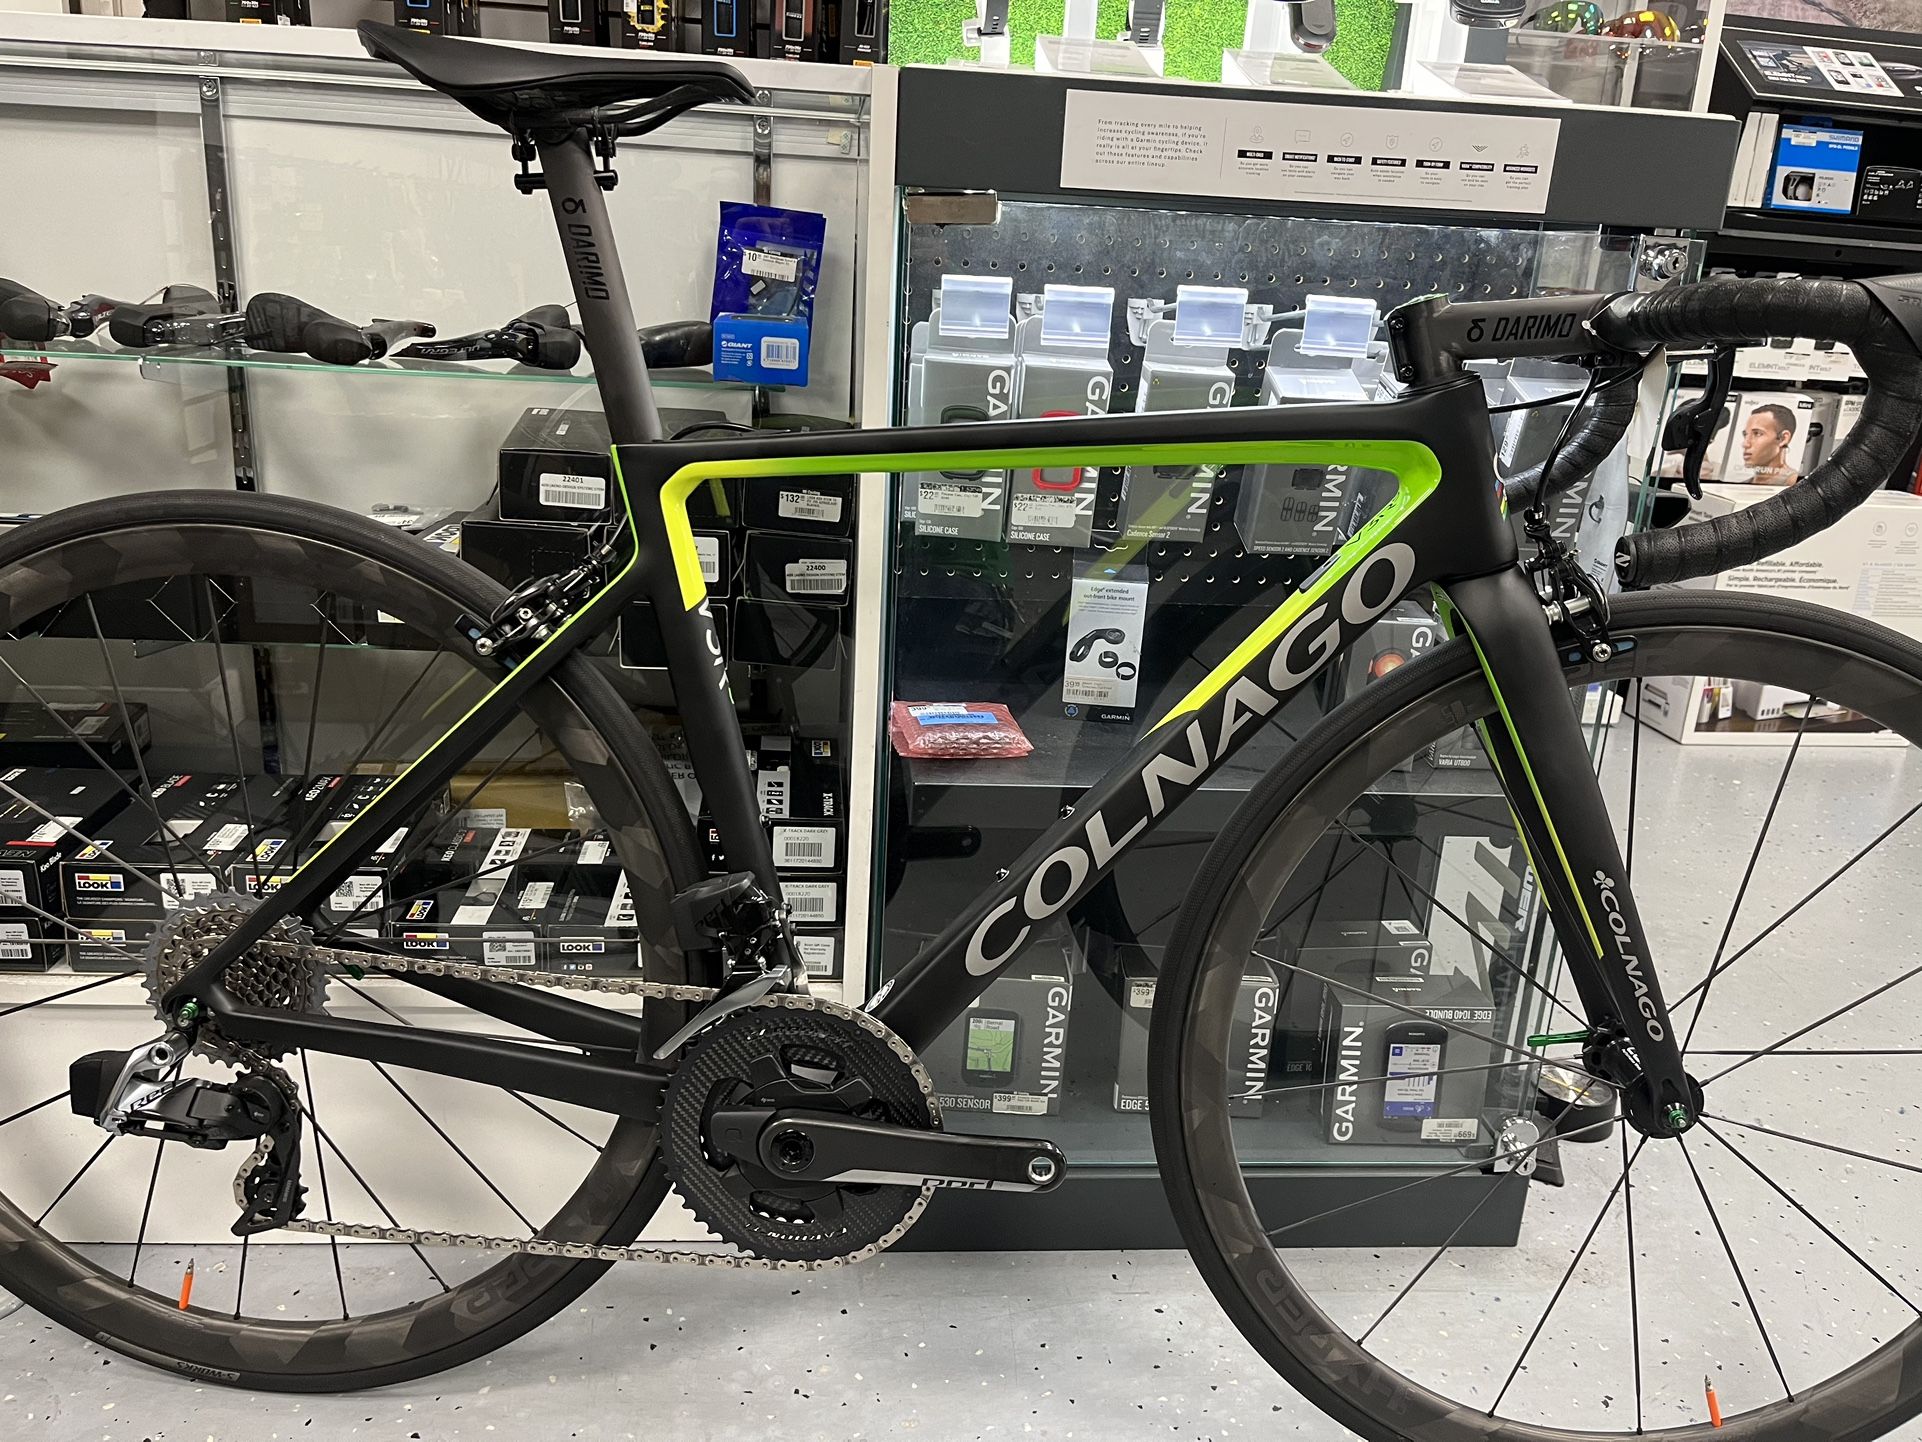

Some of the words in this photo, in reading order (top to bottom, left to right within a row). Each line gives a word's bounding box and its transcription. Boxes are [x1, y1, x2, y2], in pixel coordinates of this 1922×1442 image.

[1141, 121, 1157, 129] every
[1180, 124, 1202, 132] helping
[568, 224, 610, 300] DARIMO
[1491, 313, 1577, 342] DARIMO
[562, 476, 584, 484] 22401
[920, 490, 934, 500] $22
[1014, 502, 1027, 511] $22
[919, 524, 944, 534] SILICONE
[945, 527, 958, 535] CASE
[1127, 529, 1147, 537] Cadence
[1148, 530, 1165, 538] Sensor
[1010, 531, 1035, 539] SILICONE
[966, 542, 1416, 976] COLNAGO
[78, 881, 110, 889] LOOK
[405, 940, 435, 948] LOOK
[1600, 889, 1664, 1042] COLNAGO
[1426, 1010, 1452, 1019] BUNDLE
[1454, 1010, 1470, 1019] 1040
[1473, 1010, 1492, 1019] EDGE
[1040, 987, 1068, 1098] GARMIN
[1245, 987, 1274, 1100] GARMIN
[1333, 1026, 1363, 1141] GARMIN
[940, 1097, 955, 1107] 530
[957, 1098, 991, 1109] SENSOR
[1121, 1100, 1143, 1110] EDGE
[176, 1362, 235, 1380] S-WORKS
